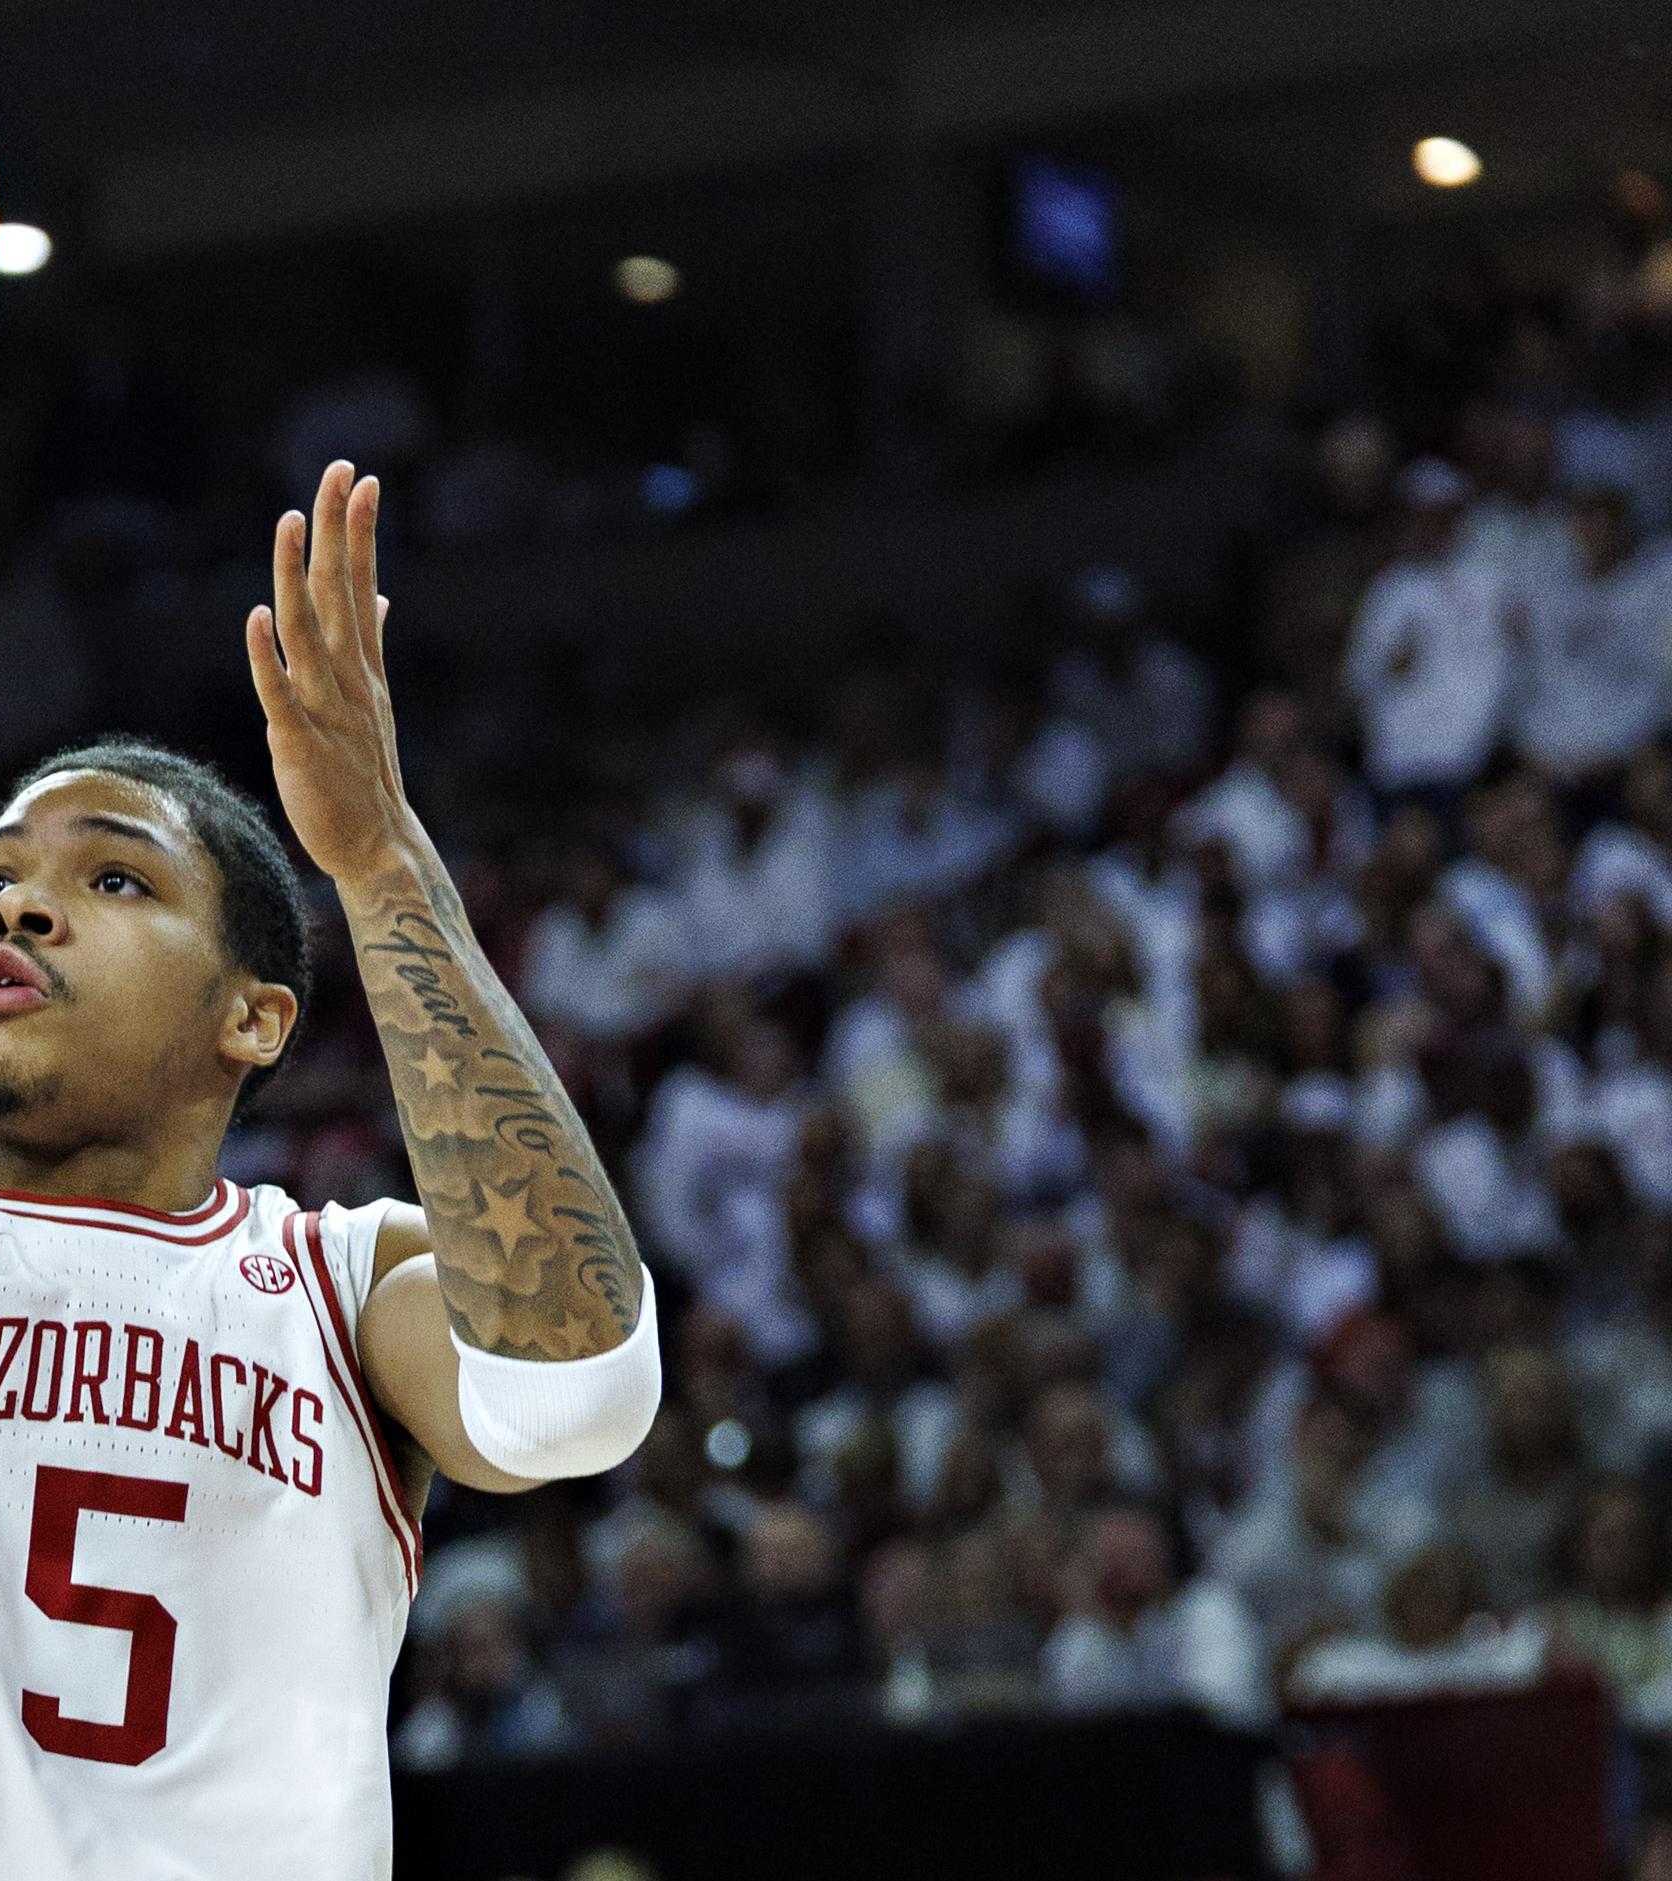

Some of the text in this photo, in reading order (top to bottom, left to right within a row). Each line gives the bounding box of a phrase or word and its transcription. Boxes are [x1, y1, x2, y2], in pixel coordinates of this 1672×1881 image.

[364, 911, 478, 1041] Fear
[474, 1048, 563, 1159] No
[241, 1255, 293, 1293] SEC
[21, 1464, 190, 1767] 5
